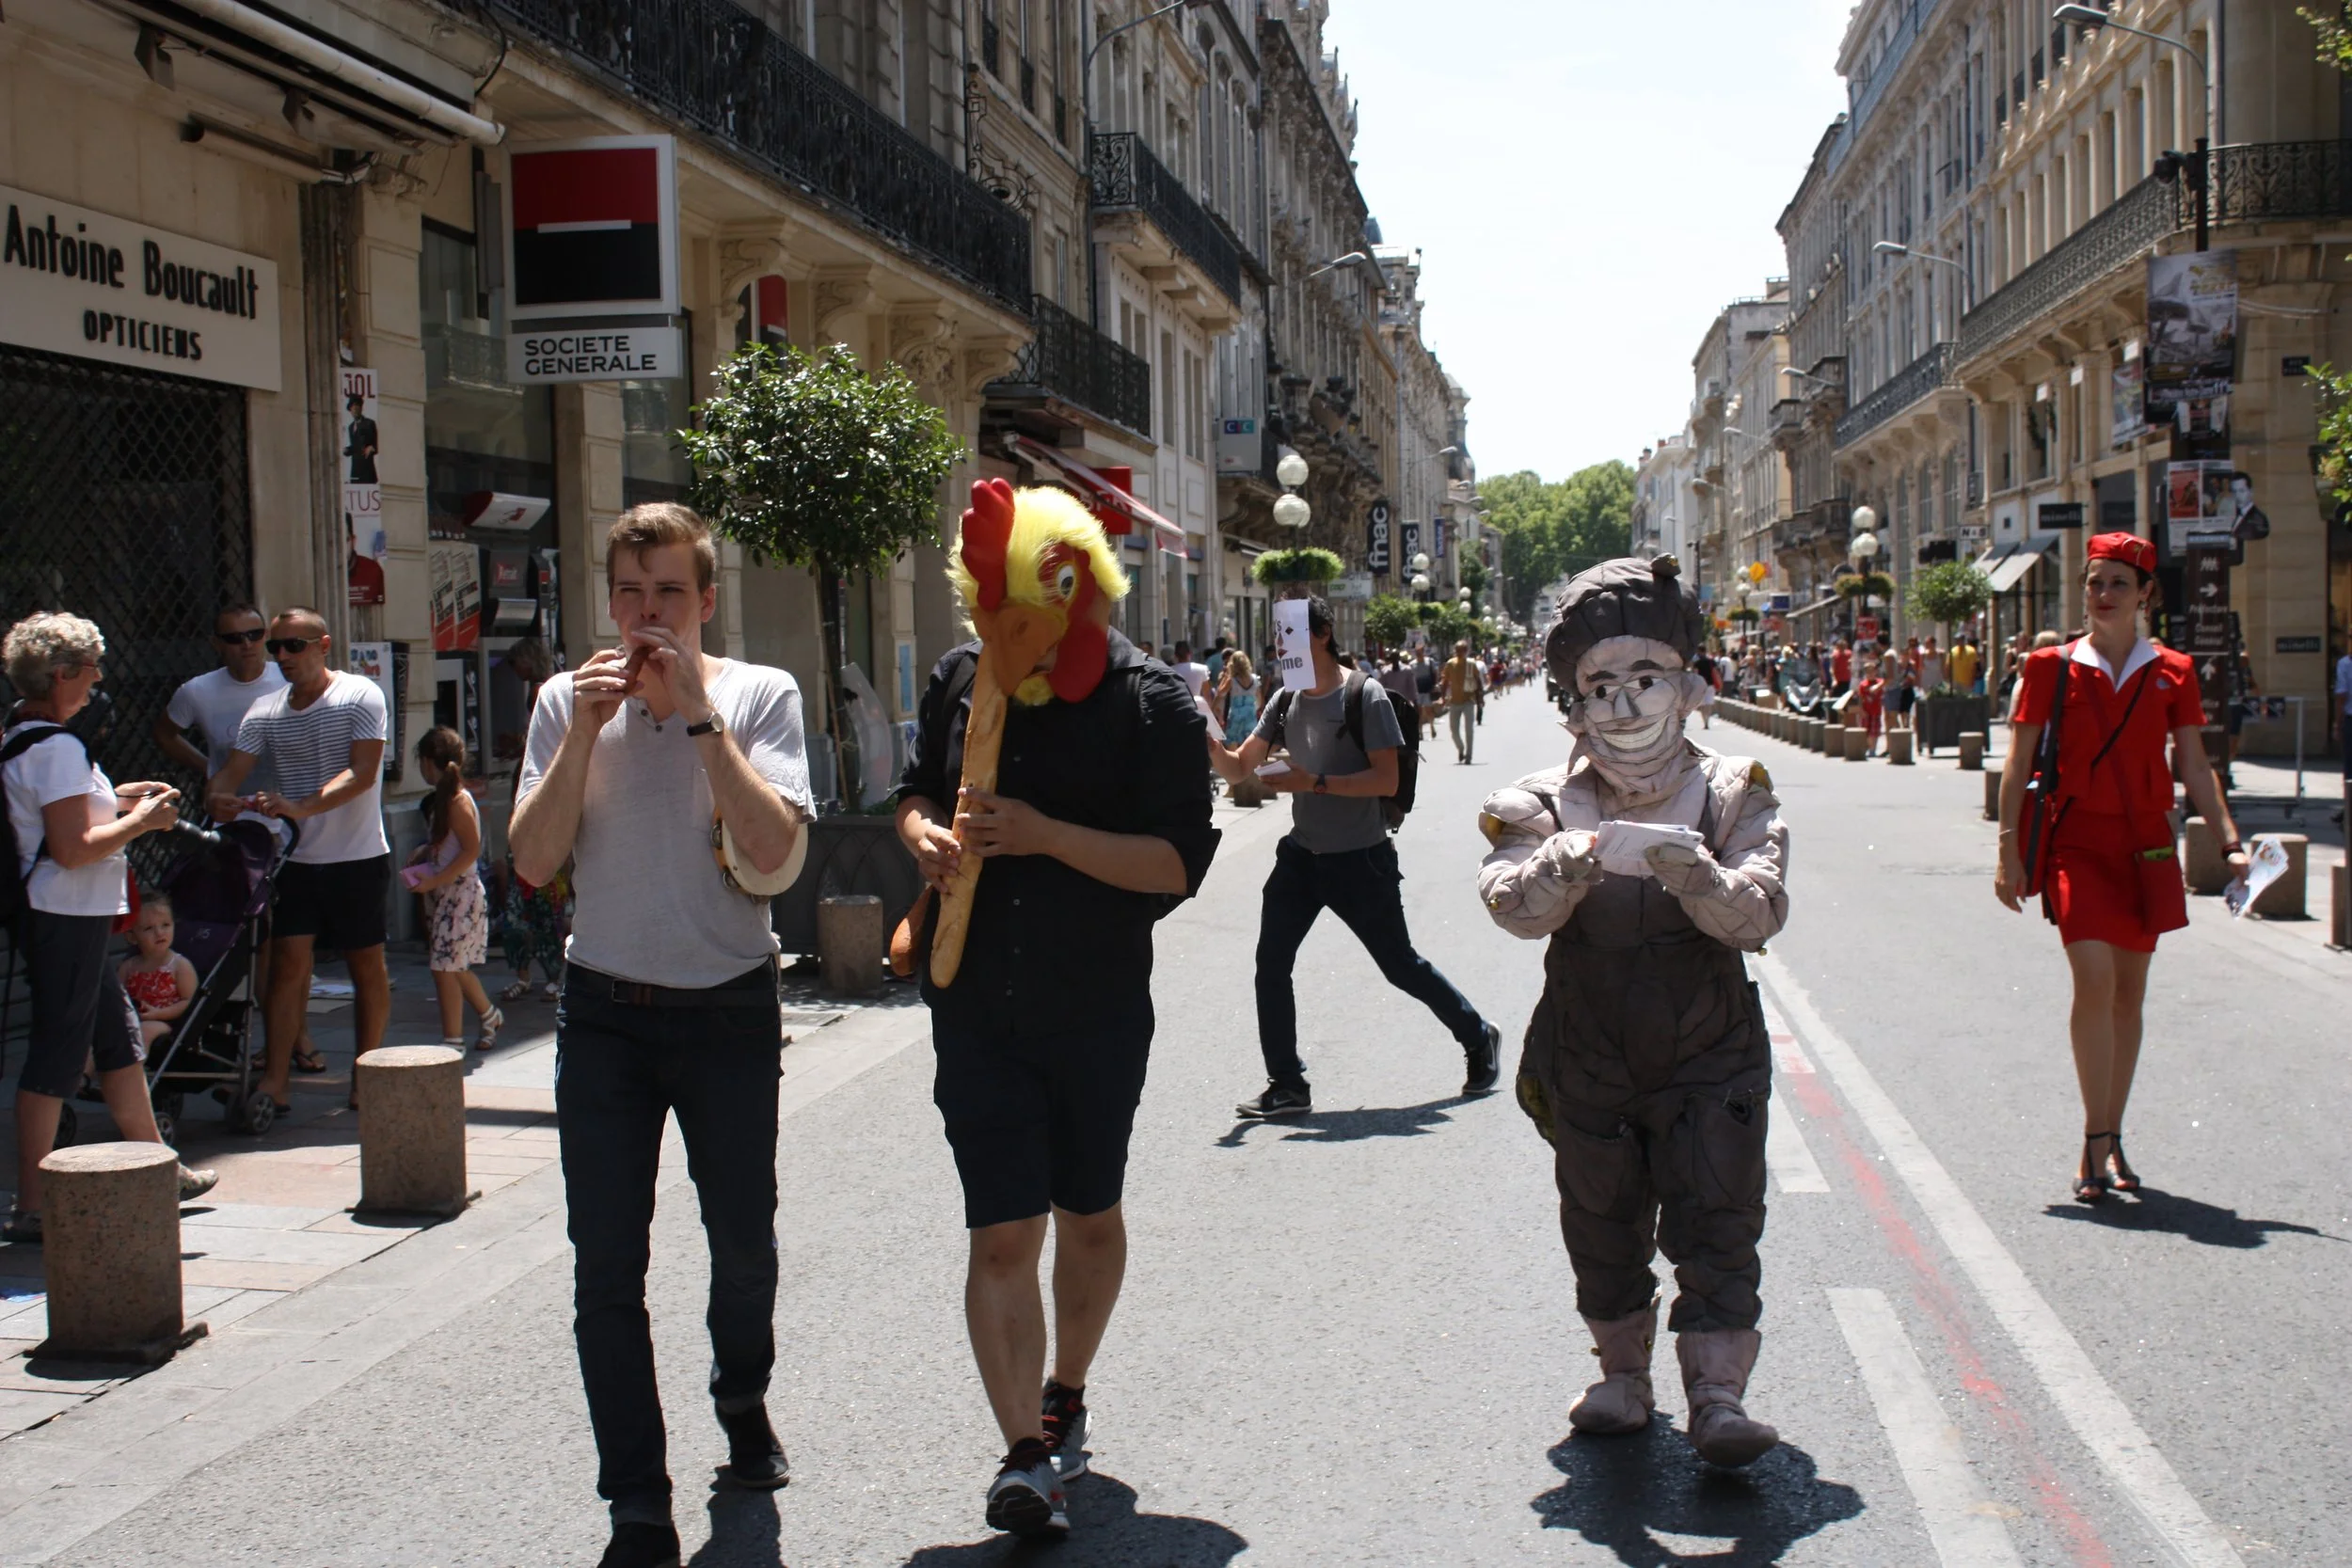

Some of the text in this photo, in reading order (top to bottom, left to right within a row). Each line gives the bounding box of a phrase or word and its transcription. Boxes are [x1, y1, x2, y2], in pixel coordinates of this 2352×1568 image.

[4, 204, 259, 320] Antoine Boucault
[83, 309, 202, 360] OPTICIENS
[525, 335, 630, 356] SOCIETE
[525, 354, 657, 375] GENERALE
[341, 373, 375, 399] JOL
[345, 490, 381, 512] TUS
[1368, 507, 1389, 568] fnac
[1281, 657, 1304, 671] me
